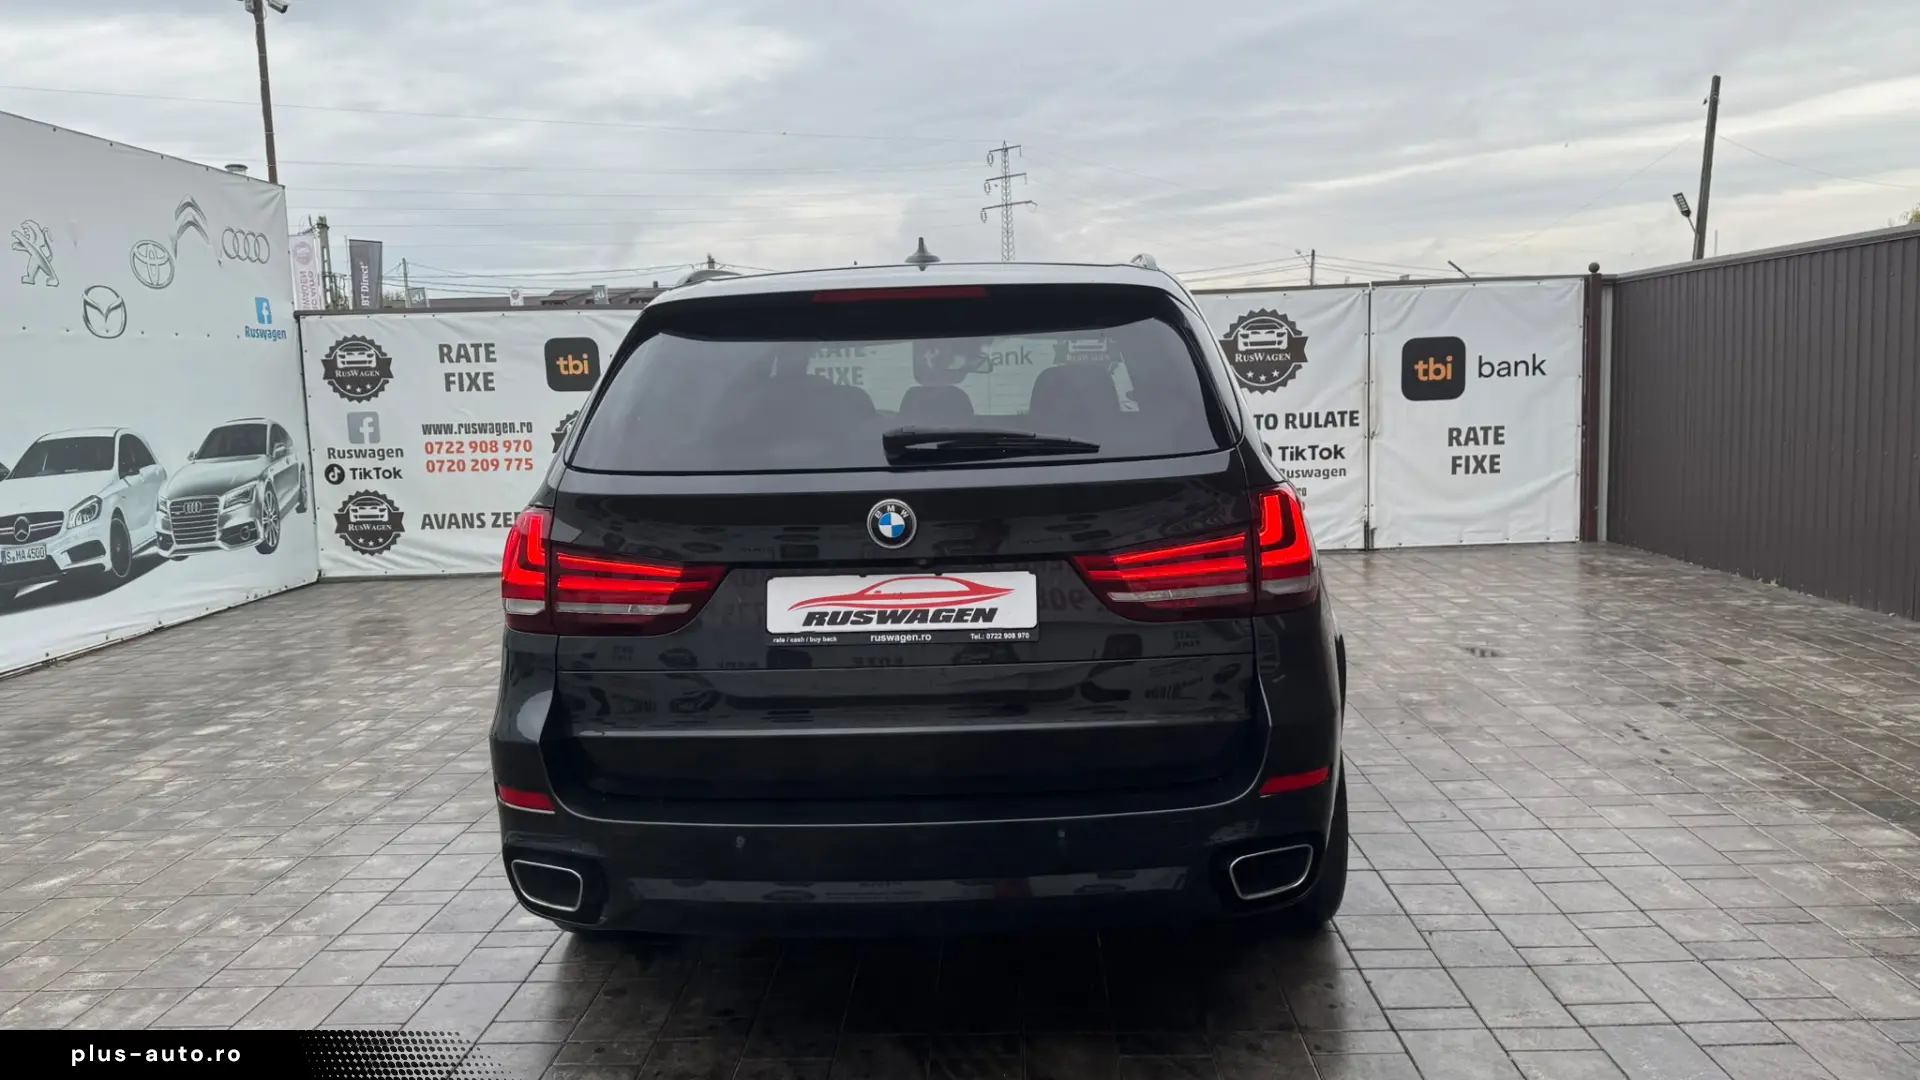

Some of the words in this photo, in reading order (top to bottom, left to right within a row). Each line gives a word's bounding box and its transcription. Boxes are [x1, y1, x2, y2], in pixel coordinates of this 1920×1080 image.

[360, 264, 369, 294] Direct
[244, 325, 287, 342] Ruswagen
[438, 343, 497, 364] RATE
[991, 346, 1034, 366] ank
[556, 353, 590, 375] tbi
[1414, 356, 1453, 381] tbi
[1478, 353, 1548, 378] bank
[444, 372, 496, 392] FIXE
[421, 421, 533, 436] www.ruswagen.ro
[1284, 410, 1360, 430] RULATE
[1447, 426, 1506, 447] RATE
[327, 447, 404, 461] Ruswagen
[424, 440, 465, 455] 0722
[468, 440, 499, 453] 908
[502, 439, 533, 453] 970
[1278, 444, 1346, 461] TikTok
[349, 466, 403, 480] TikTok
[426, 458, 466, 473] 0720
[470, 458, 500, 472] 209
[504, 457, 534, 471] 775
[1451, 454, 1501, 475] FIXE
[421, 512, 487, 530] AVANS
[27, 546, 45, 560] 4500
[802, 607, 998, 627] RUSWAGEN
[870, 632, 932, 644] ruswagen.ro
[986, 632, 1002, 640] 0722
[1004, 632, 1016, 640] 908
